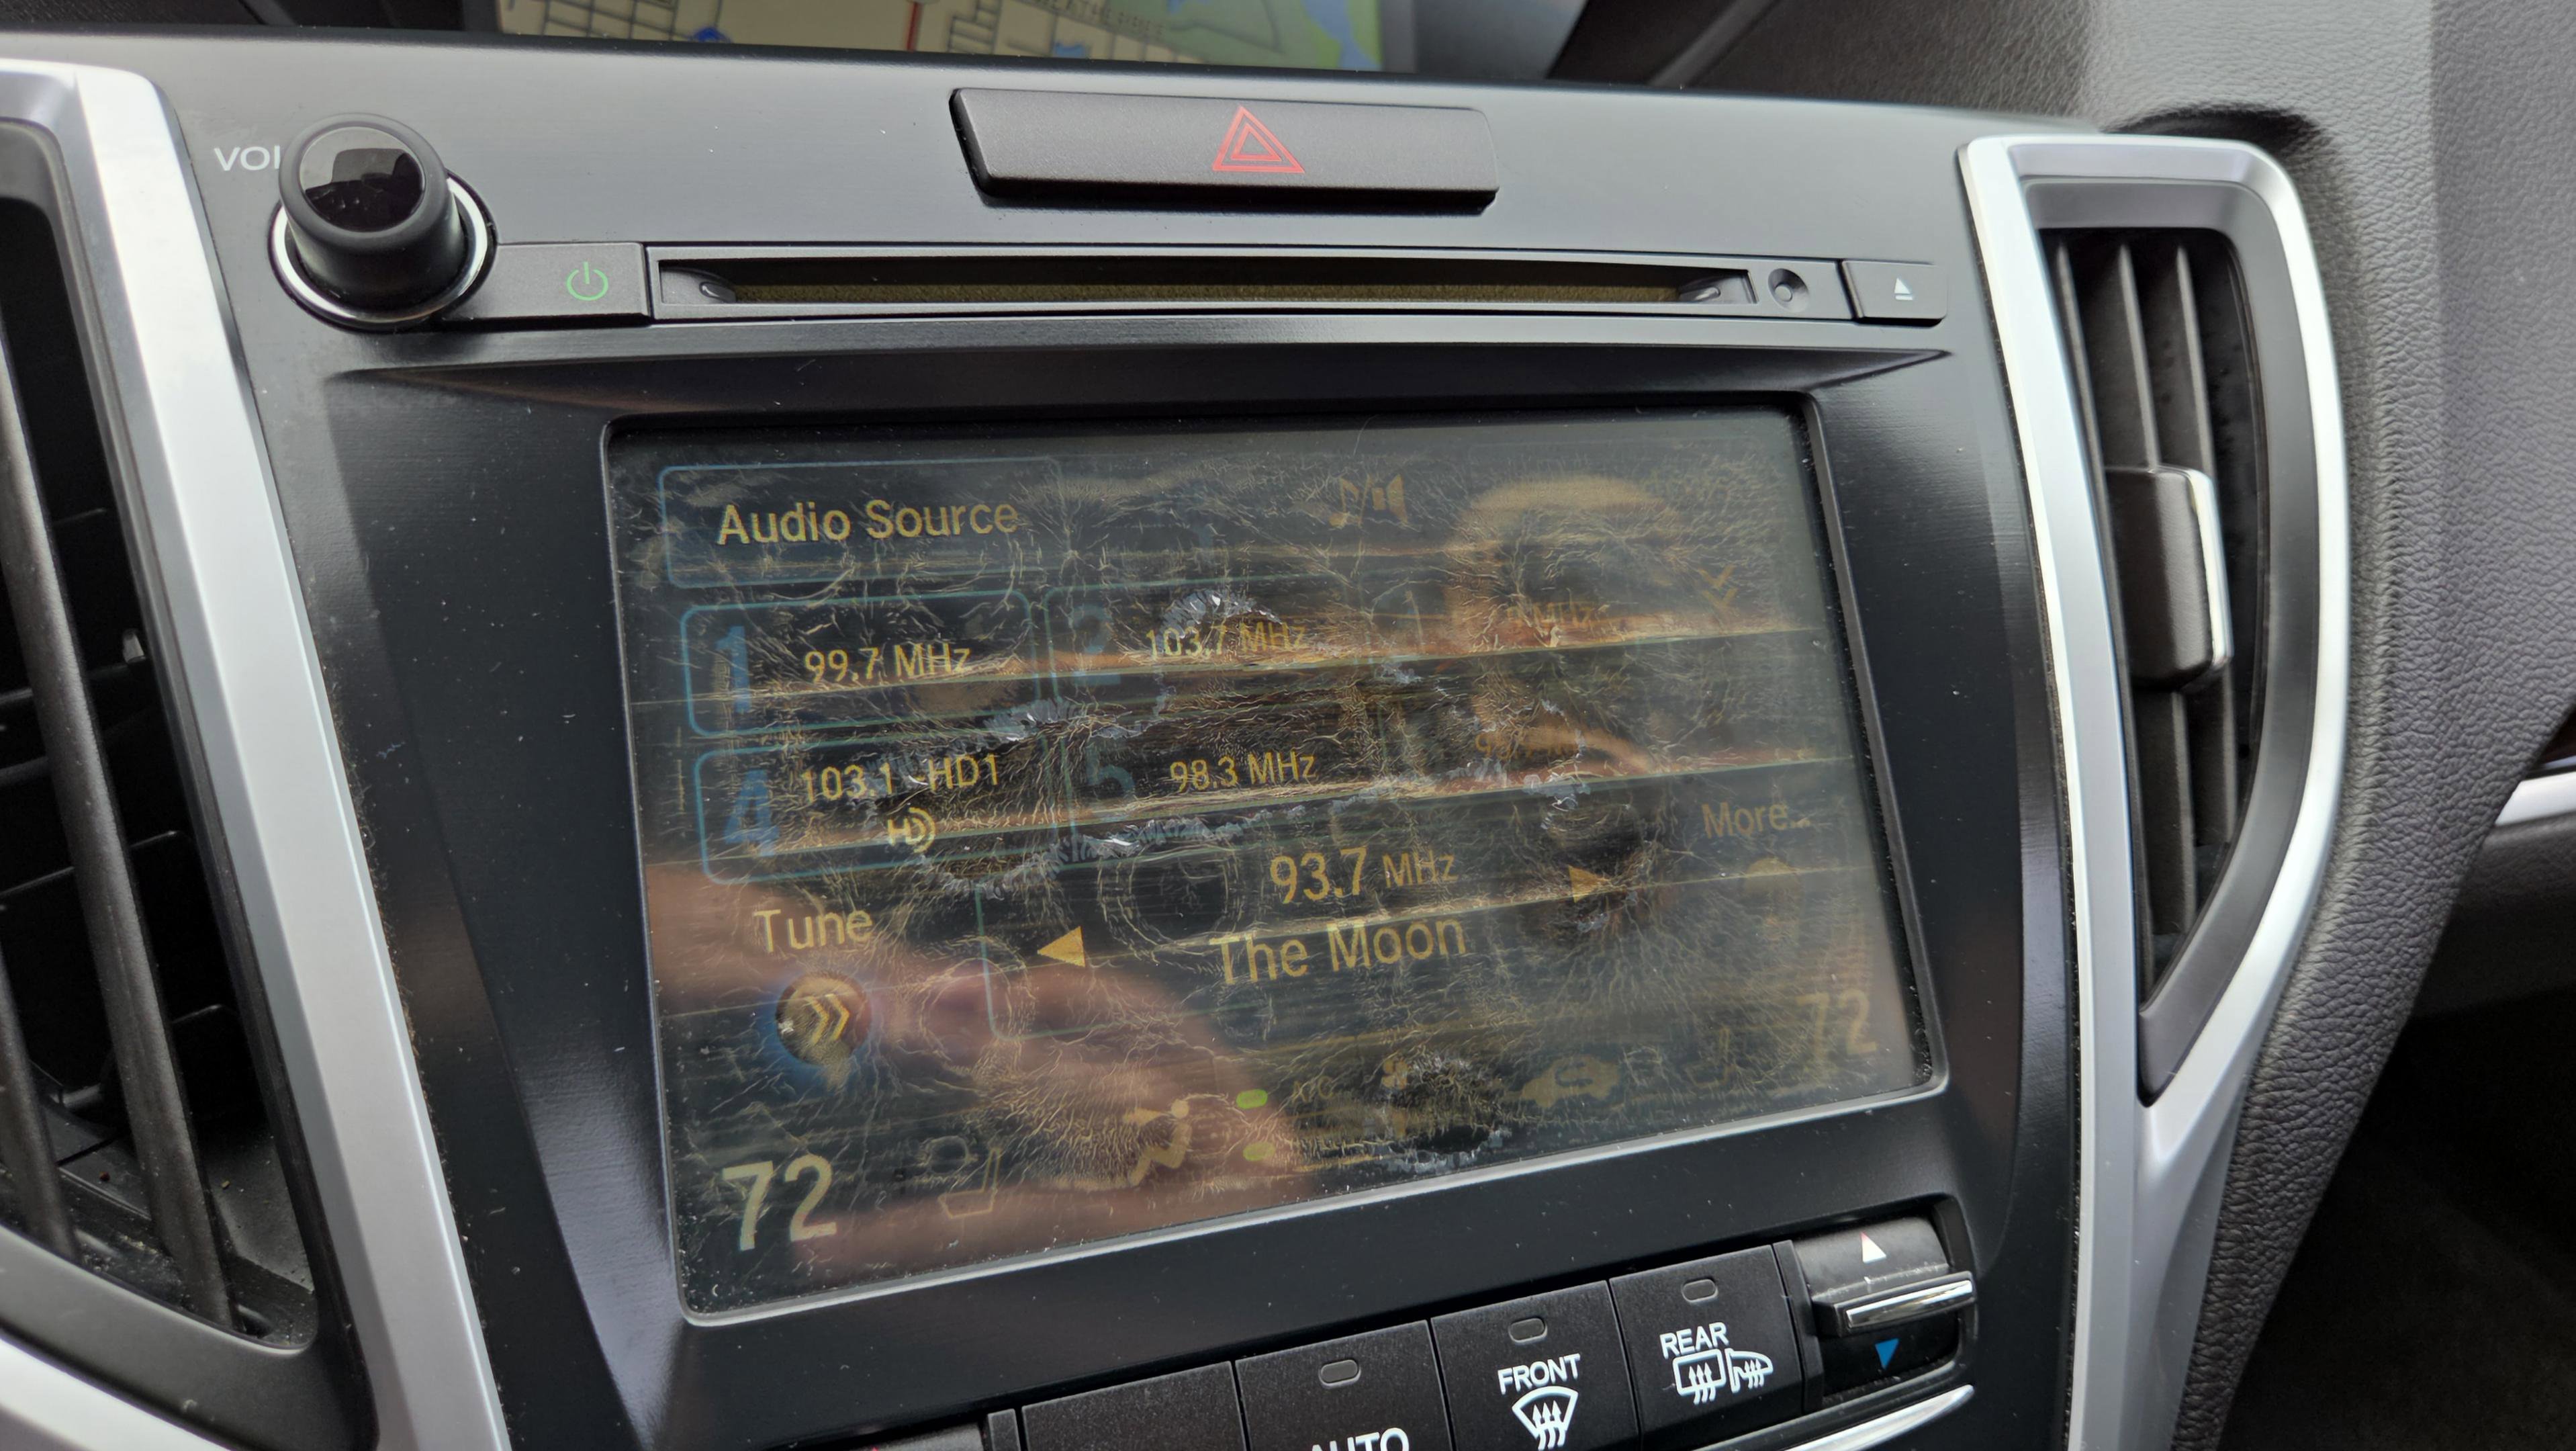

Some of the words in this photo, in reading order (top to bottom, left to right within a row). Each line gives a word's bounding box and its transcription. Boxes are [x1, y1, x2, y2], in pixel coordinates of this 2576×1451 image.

[718, 502, 851, 545] Audio
[866, 499, 1020, 539] Source
[1146, 624, 1228, 660] 103.7
[1240, 621, 1305, 653] MHz
[805, 648, 877, 683] 99.7
[894, 643, 970, 678] MHz
[801, 762, 893, 803] 103.1
[1170, 756, 1238, 792] 98.3
[1246, 750, 1316, 785] MHz
[1271, 847, 1367, 904] 93.7
[1382, 850, 1457, 888] MHz
[754, 909, 873, 953] Tune
[1210, 933, 1307, 985] The
[1326, 917, 1466, 972] Moon
[722, 1153, 837, 1251] 72
[1659, 1321, 1729, 1359] REAR
[1498, 1352, 1581, 1395] FRONT
